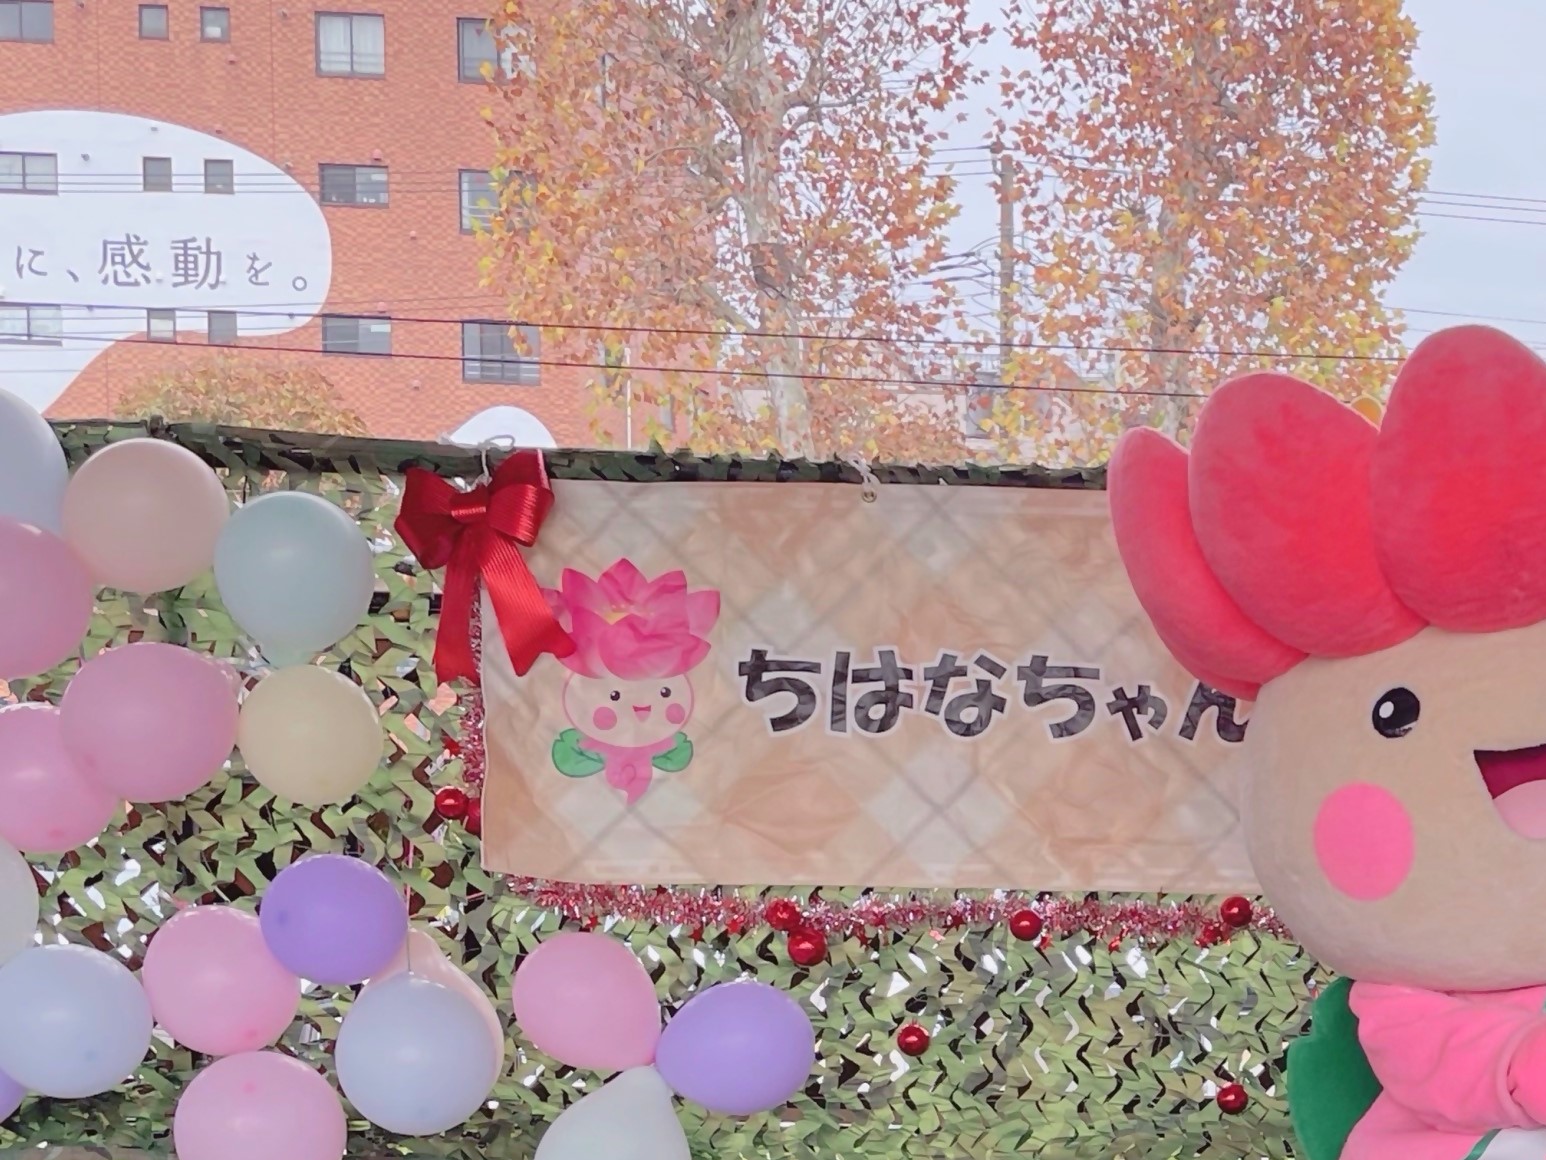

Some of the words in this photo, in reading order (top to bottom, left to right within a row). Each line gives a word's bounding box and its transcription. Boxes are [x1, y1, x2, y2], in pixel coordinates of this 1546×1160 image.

[16, 233, 307, 290] に、感動を。
[738, 648, 1249, 743] ちはなちゃん
